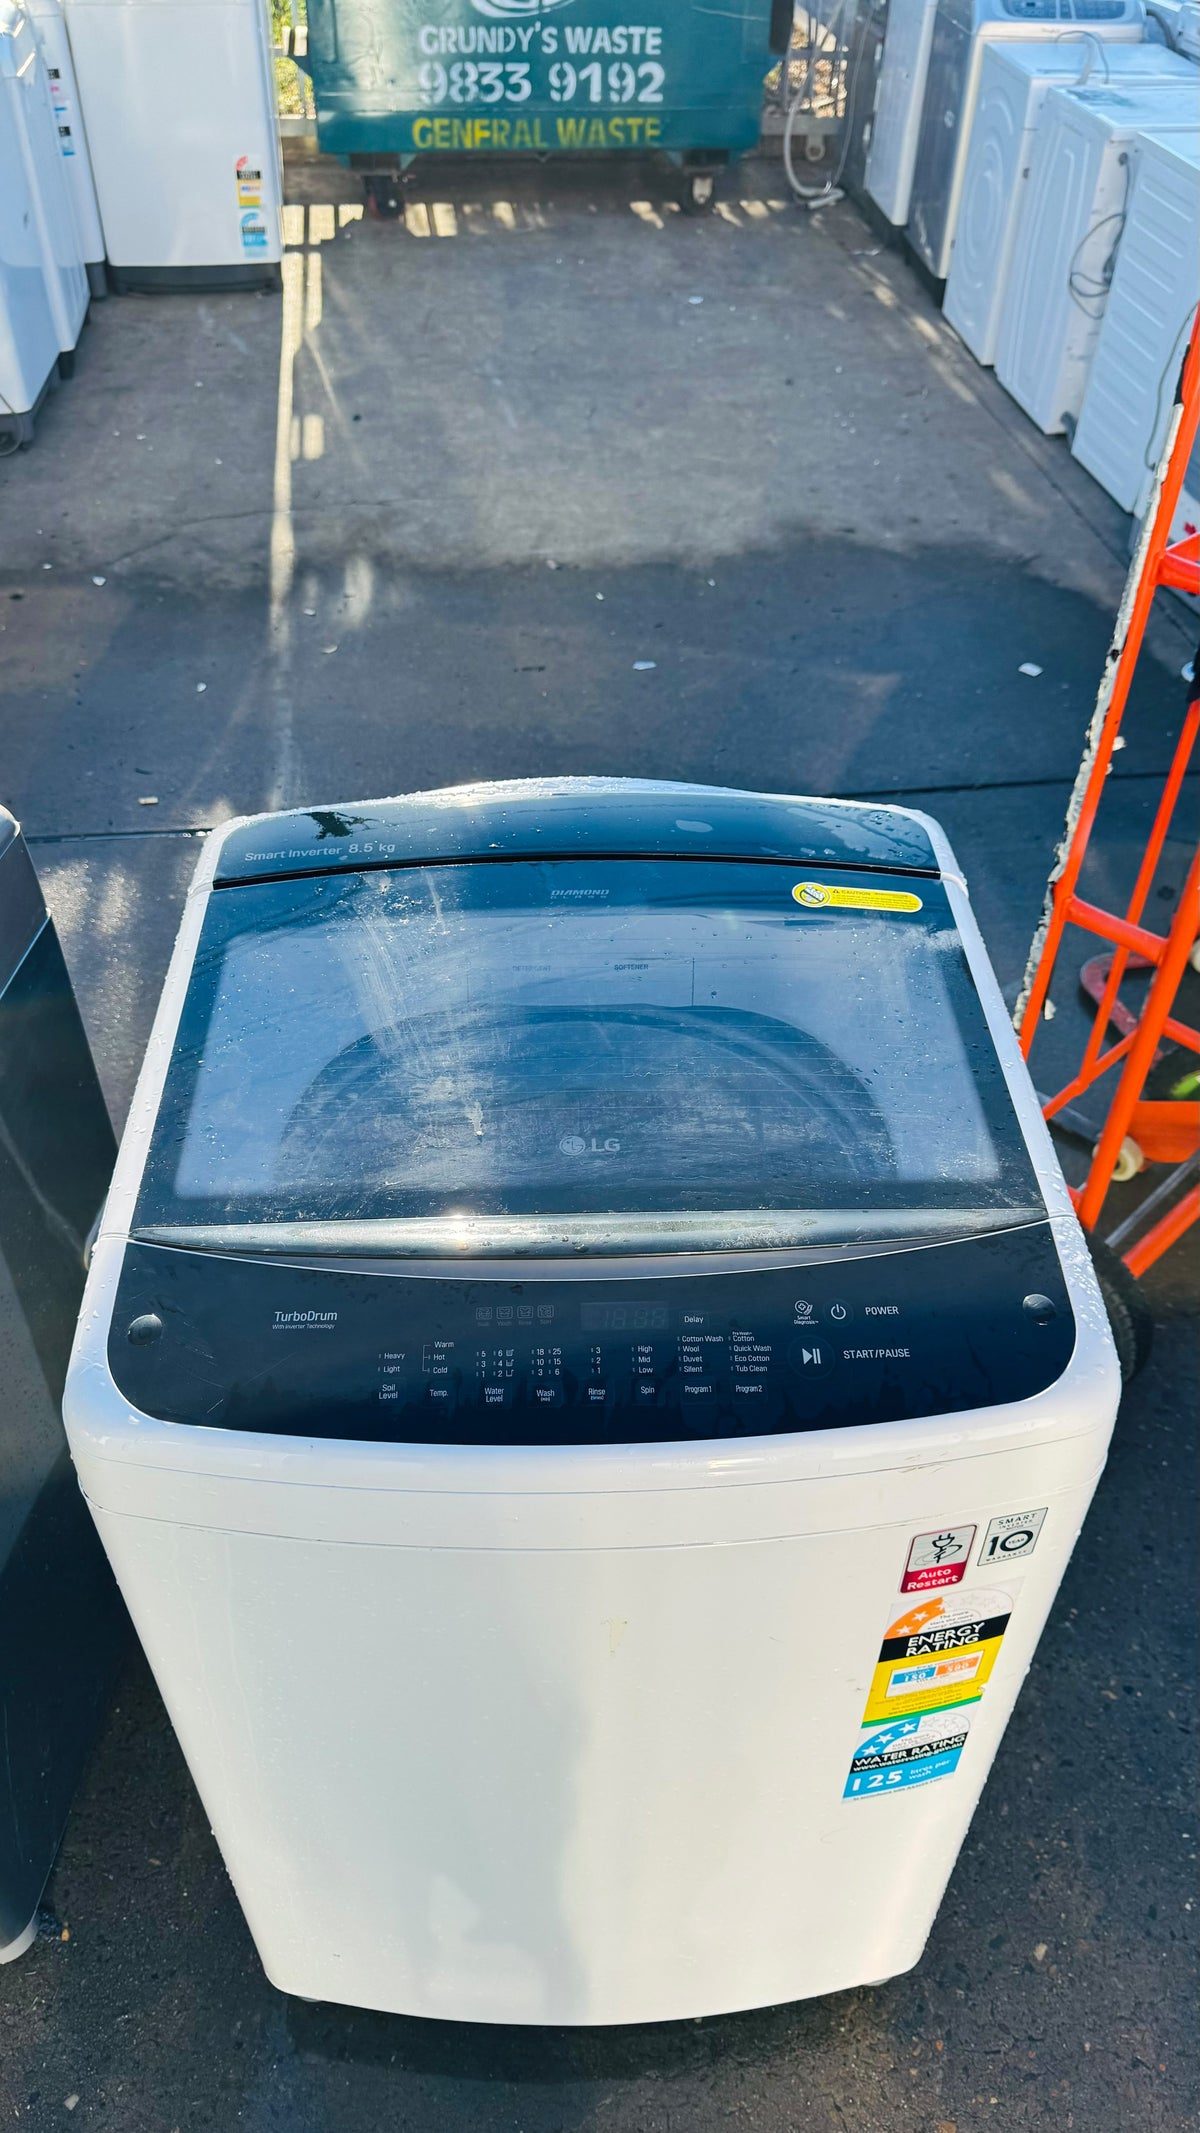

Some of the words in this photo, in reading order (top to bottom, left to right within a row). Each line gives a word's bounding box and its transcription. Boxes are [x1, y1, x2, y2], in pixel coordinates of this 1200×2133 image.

[419, 21, 558, 54] GRUNDY'S
[565, 26, 662, 54] WASTE
[418, 61, 532, 103] 9833
[549, 61, 665, 102] 9192
[557, 117, 661, 146] WASTE
[245, 851, 285, 862] Smart
[288, 847, 342, 858] Inverter
[348, 843, 373, 854] 8.5
[379, 843, 395, 854] kg
[614, 963, 649, 971] SOFTENER
[591, 1138, 621, 1152] LG
[865, 1306, 899, 1315] POWER
[274, 1310, 338, 1322] TurboDrum
[684, 1316, 704, 1324] Delay
[843, 1349, 911, 1359] START/PAUSE
[537, 1358, 545, 1366] 10
[383, 1365, 401, 1373] Light
[433, 1366, 448, 1374] Cold
[638, 1366, 654, 1374] Low
[382, 1383, 396, 1391] Soil
[484, 1387, 505, 1395] Water
[640, 1386, 655, 1395] Spin
[378, 1391, 398, 1400] Level
[429, 1389, 449, 1397] Temp.
[485, 1394, 503, 1402] Level
[536, 1389, 555, 1397] Wash
[998, 1513, 1038, 1525] SMART
[988, 1530, 1034, 1556] 10
[918, 1568, 952, 1580] Auto
[907, 1575, 959, 1591] Restart
[908, 1621, 985, 1647] ENERGY
[906, 1633, 980, 1657] RATING
[854, 1751, 908, 1767] WATER
[911, 1734, 966, 1755] RATING
[935, 1759, 952, 1769] per
